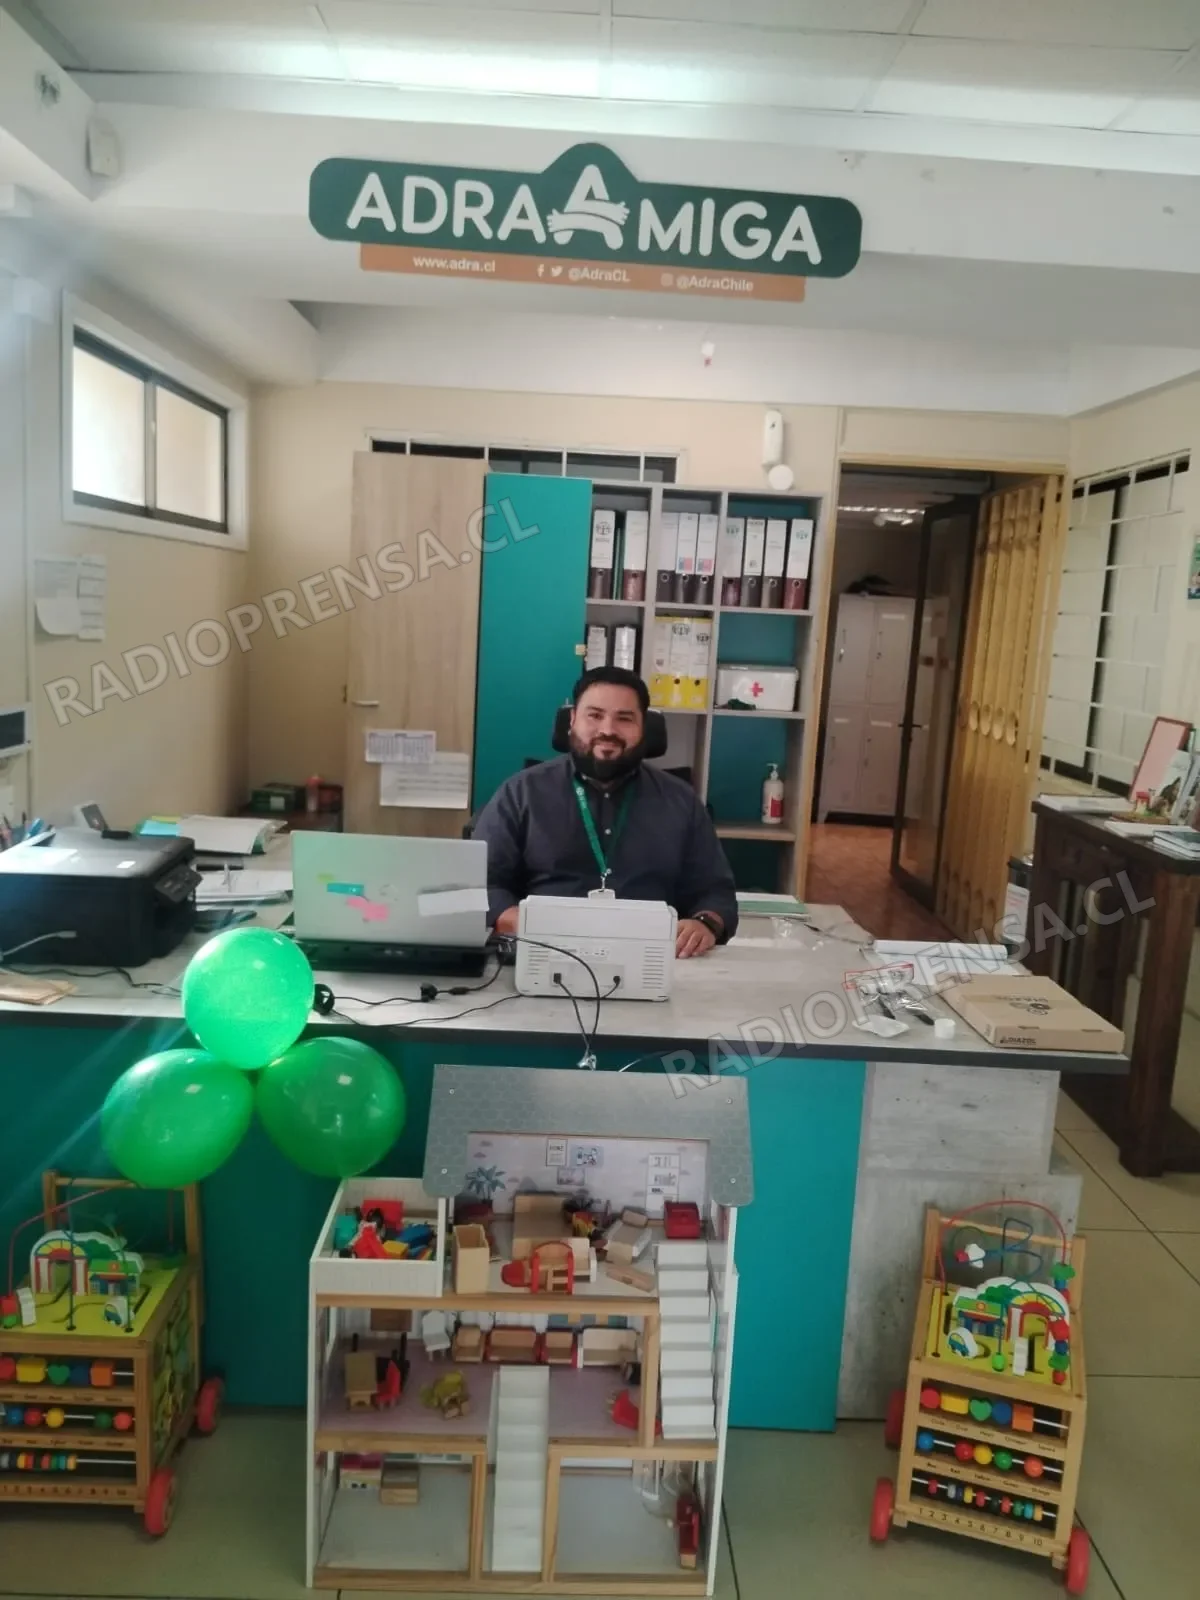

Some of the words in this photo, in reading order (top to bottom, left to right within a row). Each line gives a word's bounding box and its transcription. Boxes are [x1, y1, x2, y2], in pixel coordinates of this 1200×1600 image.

[346, 171, 547, 244] ADRA
[412, 254, 497, 273] www.adra.cl
[568, 267, 631, 284] @AdraCL
[676, 275, 754, 293] @AdraChile
